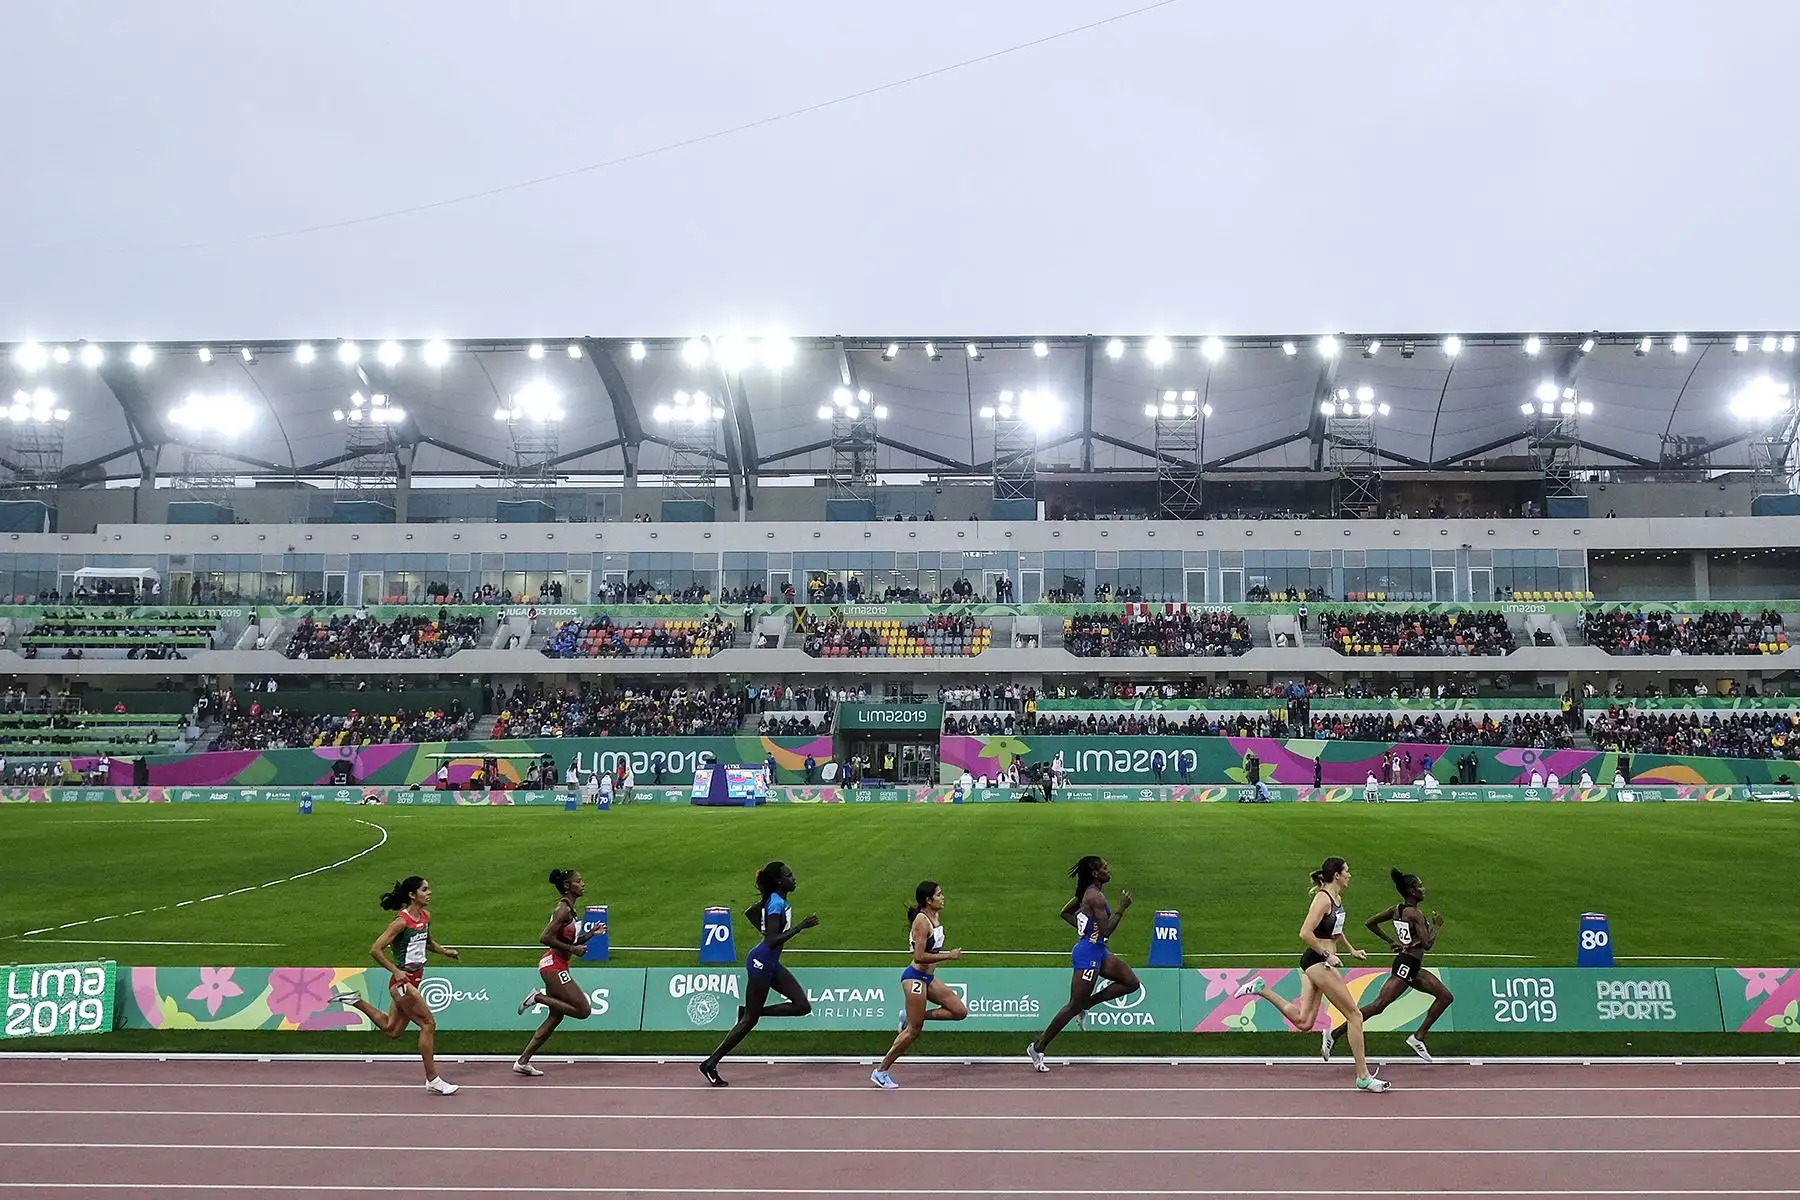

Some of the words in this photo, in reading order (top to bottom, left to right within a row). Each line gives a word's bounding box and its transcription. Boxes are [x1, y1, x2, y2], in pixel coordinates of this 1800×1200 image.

[506, 607, 547, 616] JUGAOS
[549, 607, 578, 616] TODOS
[704, 924, 730, 946] 70
[1155, 926, 1178, 940] WR
[1581, 930, 1608, 950] 80
[669, 974, 740, 999] GLORIA
[806, 988, 885, 1002] LATAM
[1596, 980, 1672, 1000] PANAM
[5, 999, 103, 1035] 2019
[1088, 1012, 1155, 1026] TOYOTA
[1494, 1000, 1557, 1023] 2019
[1596, 1001, 1677, 1020] SPORTS
